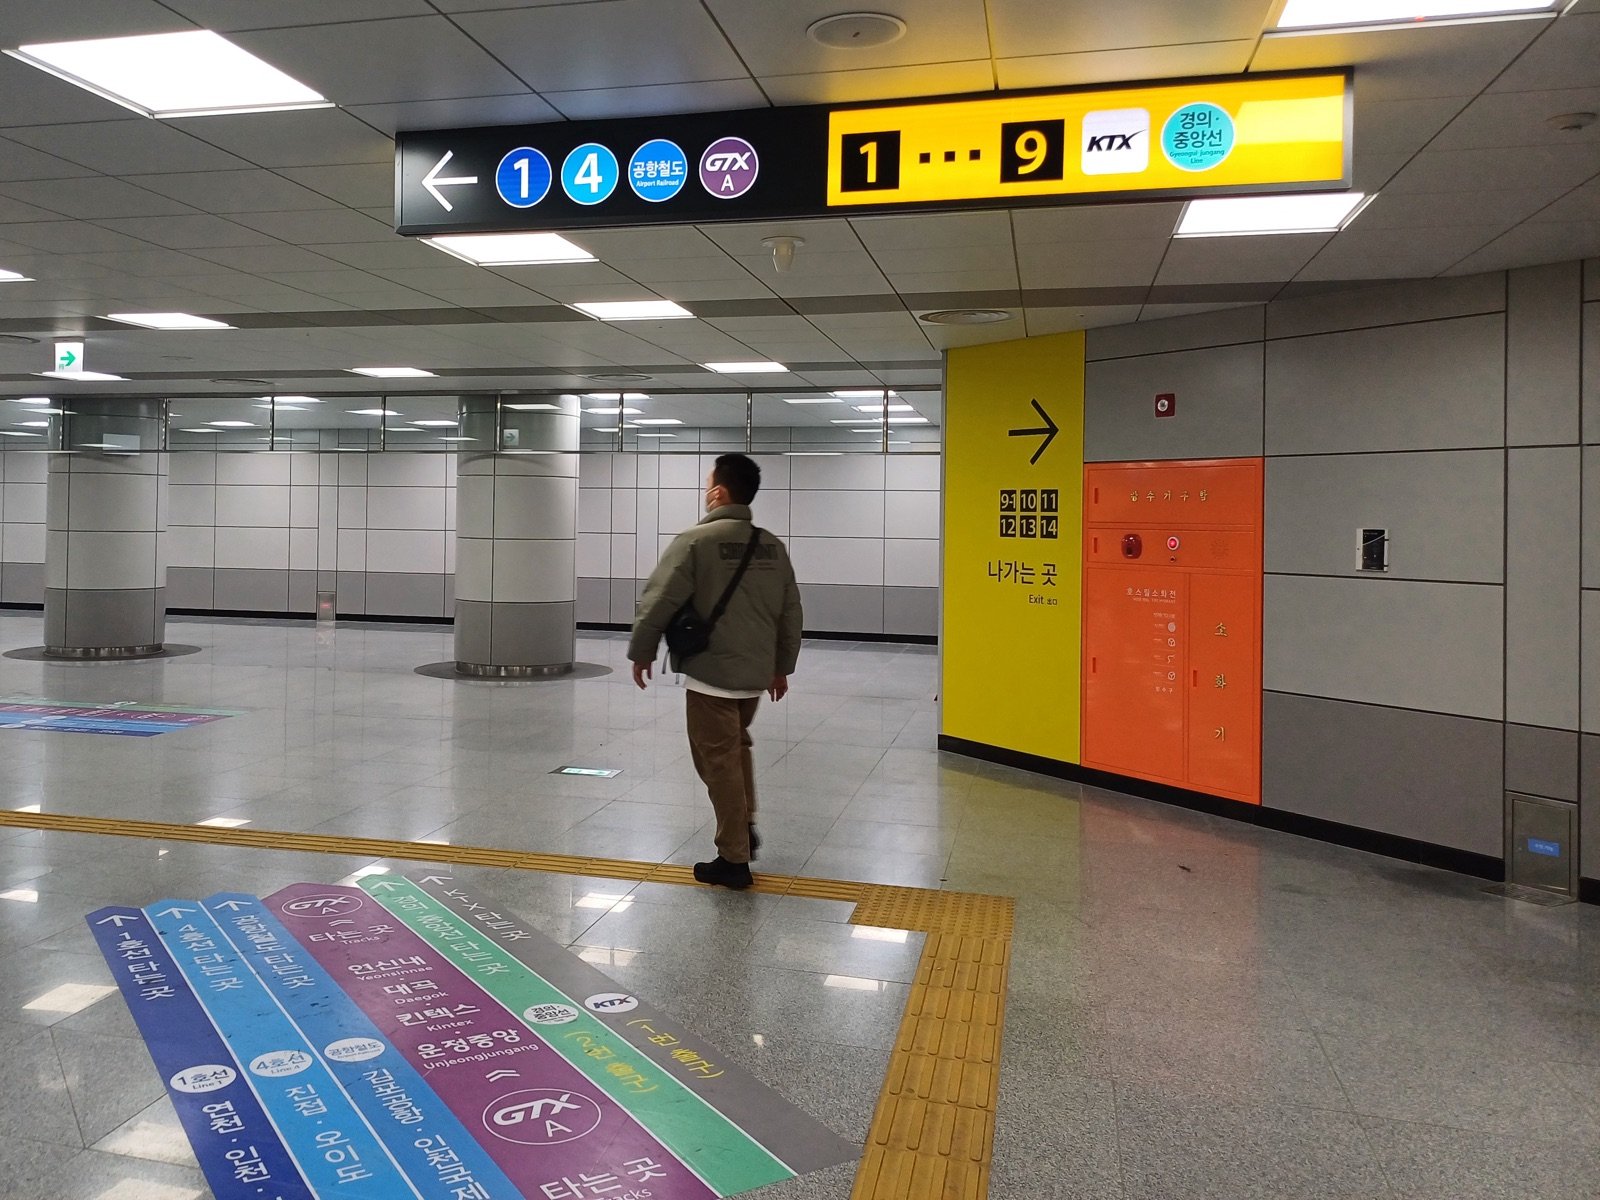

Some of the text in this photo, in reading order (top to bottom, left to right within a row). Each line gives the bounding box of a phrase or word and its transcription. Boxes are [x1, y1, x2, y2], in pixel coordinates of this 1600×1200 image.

[1086, 128, 1147, 152] KTX
[1173, 129, 1222, 150] 중앙선
[705, 152, 752, 172] GTX
[858, 140, 879, 184] 1
[1014, 129, 1048, 176] 9
[513, 157, 531, 199] 1
[574, 152, 603, 193] 4
[632, 160, 684, 179] 공항철도
[636, 179, 680, 188] Airport Railroad
[720, 174, 735, 192] A
[1001, 493, 1057, 510] 9-1 10 11
[1001, 518, 1058, 536] 12 13 14
[988, 559, 1058, 587] 나가는 곳
[1028, 594, 1044, 605] Exit
[289, 896, 351, 911] GTX
[321, 906, 340, 915] A
[308, 924, 397, 944] 타는 곳
[474, 911, 516, 931] 타는
[500, 930, 532, 941] 곳
[340, 935, 381, 947] Tracks
[178, 923, 245, 993] 4호선 타는 곳
[231, 914, 316, 990] 공항철도 타는 곳
[450, 940, 494, 962] 타는
[477, 962, 511, 976] 곳
[116, 931, 177, 1002] 1호선 타는 곳
[348, 955, 428, 977] 연신내
[356, 965, 434, 982] Yeonsinnae
[383, 979, 441, 996] 대곡
[394, 990, 450, 1006] Daegok
[593, 995, 634, 1010] KTX
[396, 1003, 482, 1028] 킨텍스
[534, 1009, 572, 1020] 중앙선
[426, 1018, 476, 1033] Kintex
[328, 1041, 382, 1056] 공항철도
[417, 1028, 521, 1061] 운정중앙
[255, 1052, 307, 1070] 4호선
[423, 1042, 540, 1071] Unjeongjungang
[177, 1068, 230, 1087] 1호선
[271, 1067, 292, 1075] Line
[192, 1081, 215, 1090] Line
[362, 1068, 425, 1125] 김포공항
[493, 1093, 582, 1126] GTX
[284, 1083, 373, 1185] 진접 오이도
[544, 1120, 573, 1138] A
[202, 1100, 272, 1185] 연천 인천
[539, 1156, 667, 1200] 타는 곳
